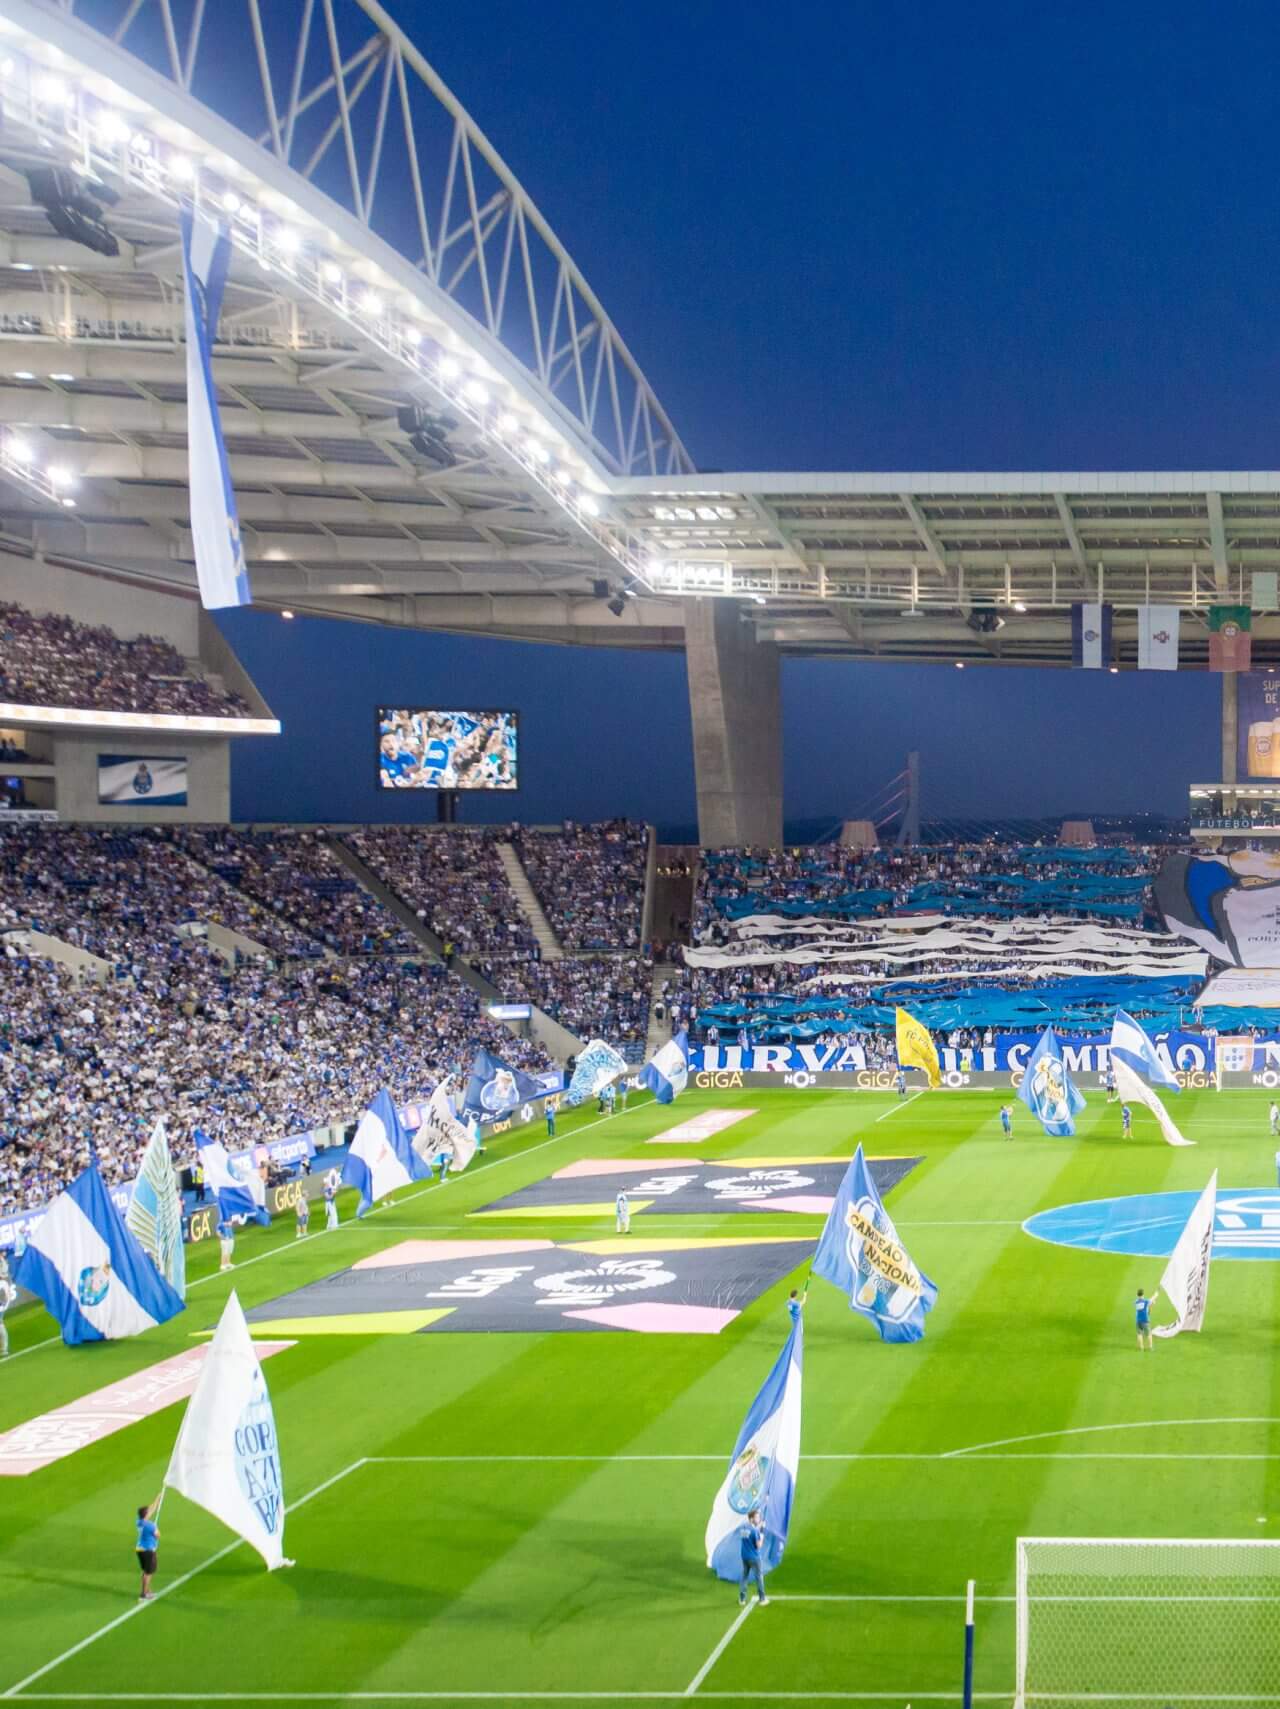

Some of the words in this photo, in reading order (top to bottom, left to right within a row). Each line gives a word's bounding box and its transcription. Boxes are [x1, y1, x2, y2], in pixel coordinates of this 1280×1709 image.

[1265, 693, 1277, 704] DE
[1199, 819, 1254, 829] FUTEBOL
[784, 1071, 816, 1088] NOS
[426, 1265, 535, 1299] LIGA
[533, 1259, 678, 1306] NOS
